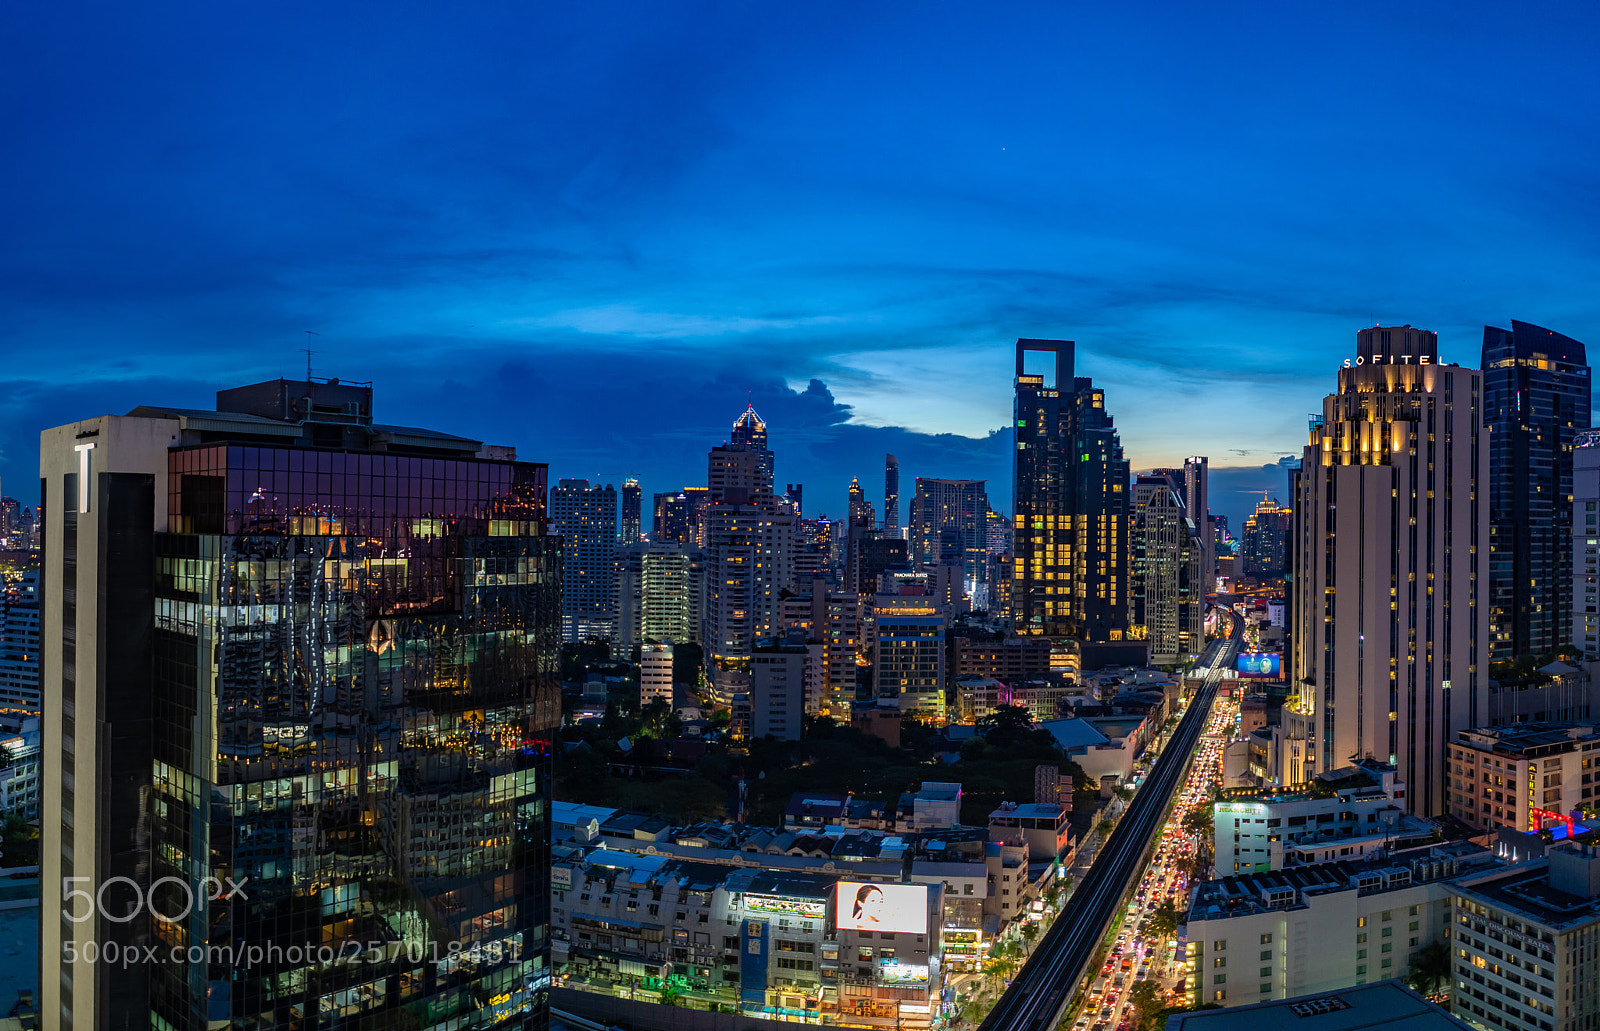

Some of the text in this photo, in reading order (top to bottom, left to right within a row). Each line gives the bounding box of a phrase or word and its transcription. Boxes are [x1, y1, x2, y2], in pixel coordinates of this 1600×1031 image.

[1343, 354, 1448, 369] SOFITEL
[1462, 911, 1550, 951] SPECIAL DISCOUNT RATES
